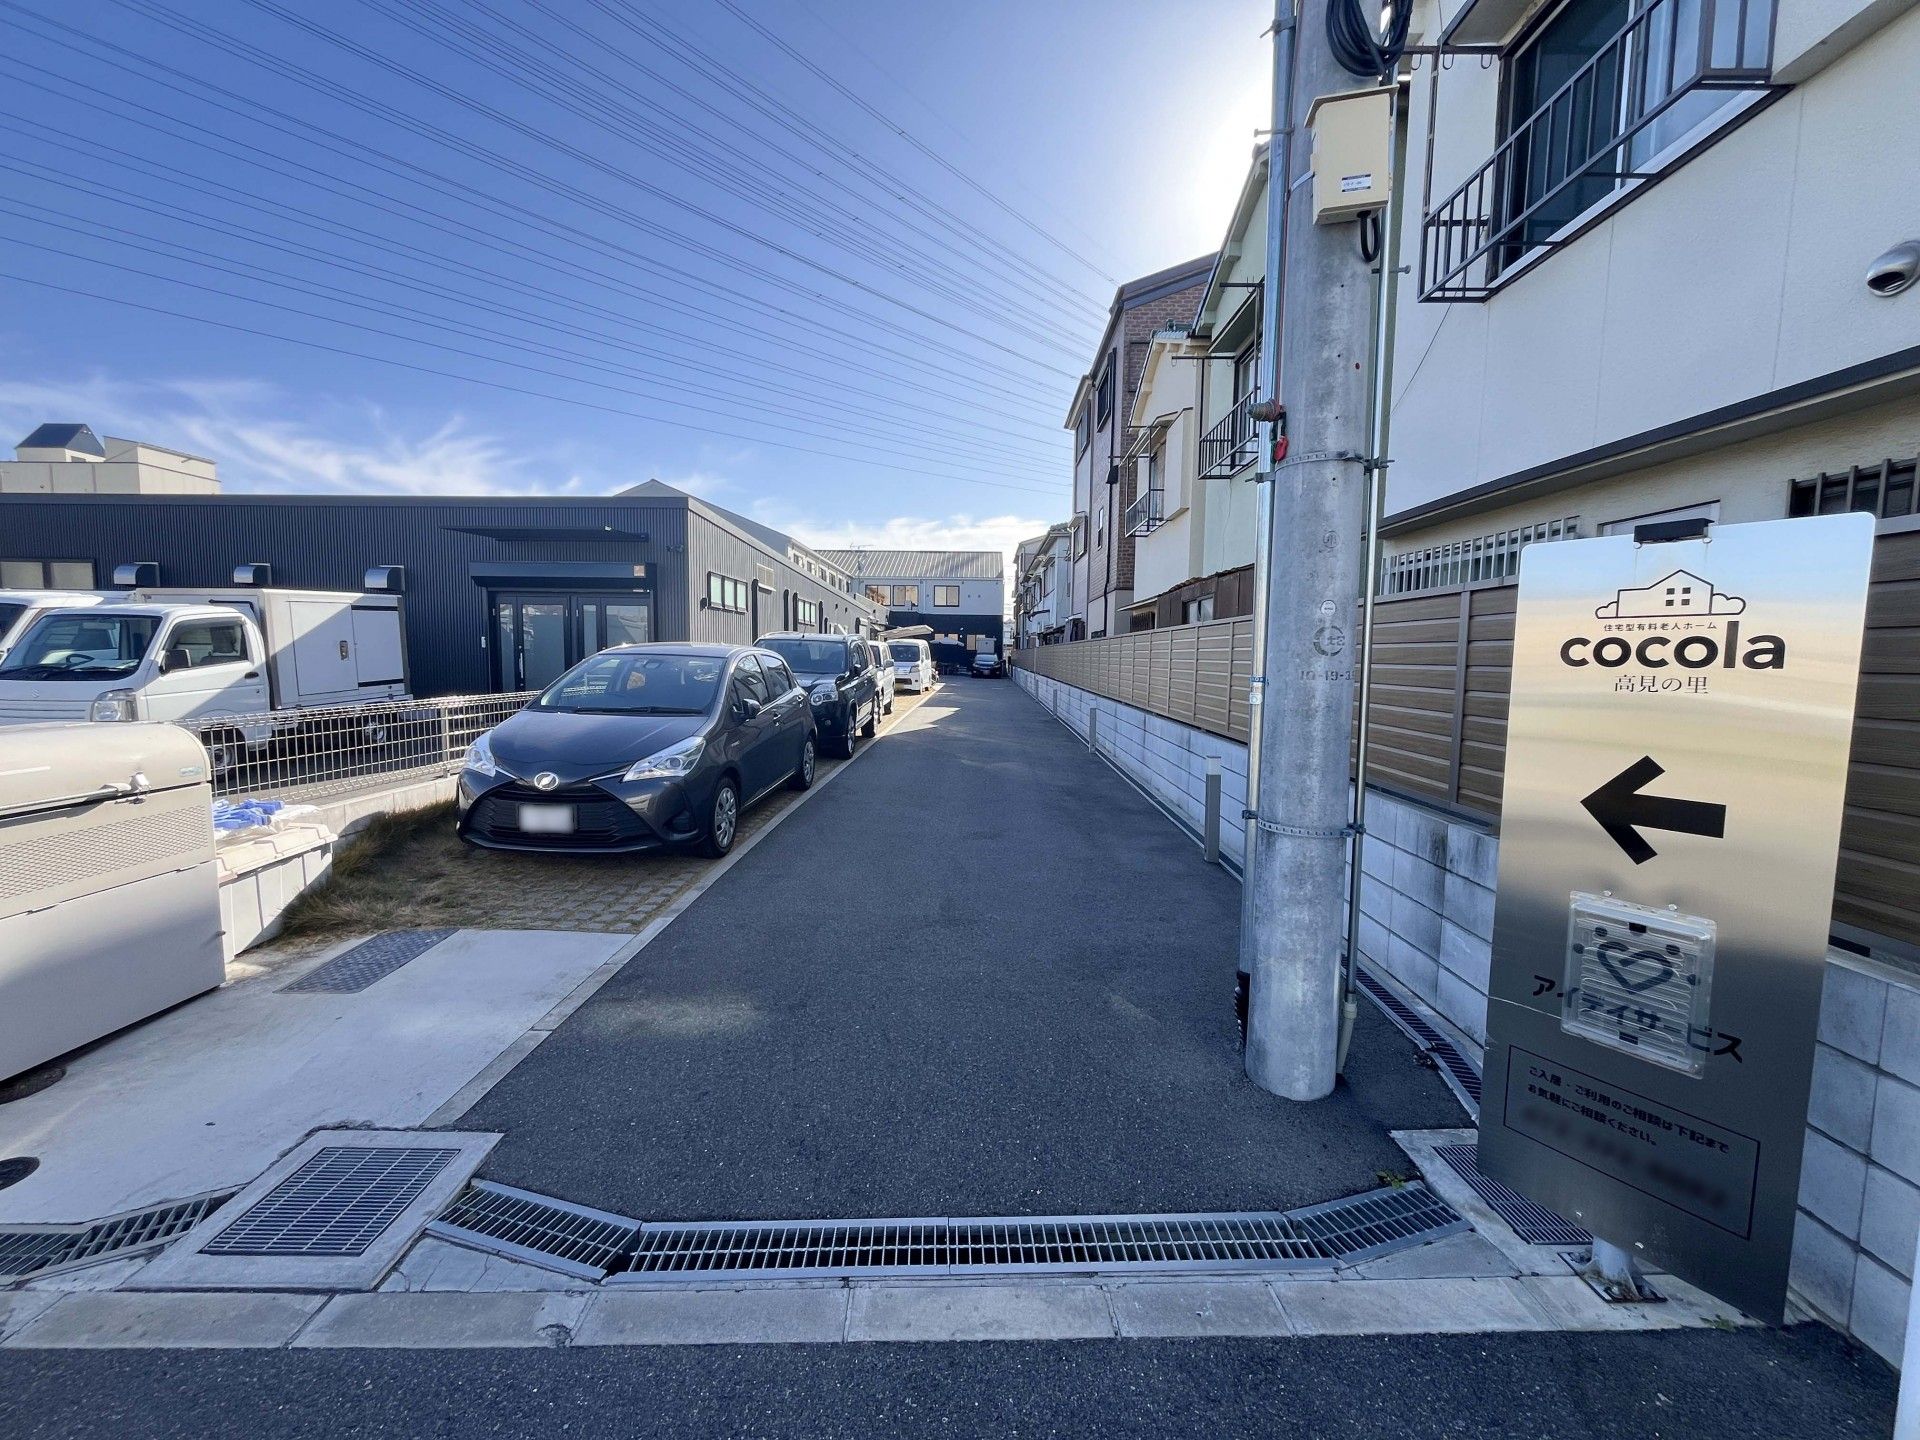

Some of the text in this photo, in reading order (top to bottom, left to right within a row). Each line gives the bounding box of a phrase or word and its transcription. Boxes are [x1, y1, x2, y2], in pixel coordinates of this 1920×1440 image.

[1603, 622, 1717, 632] 住宅型有料老人ホーム
[1560, 620, 1786, 669] cocola
[1614, 674, 1708, 694] 高見の里
